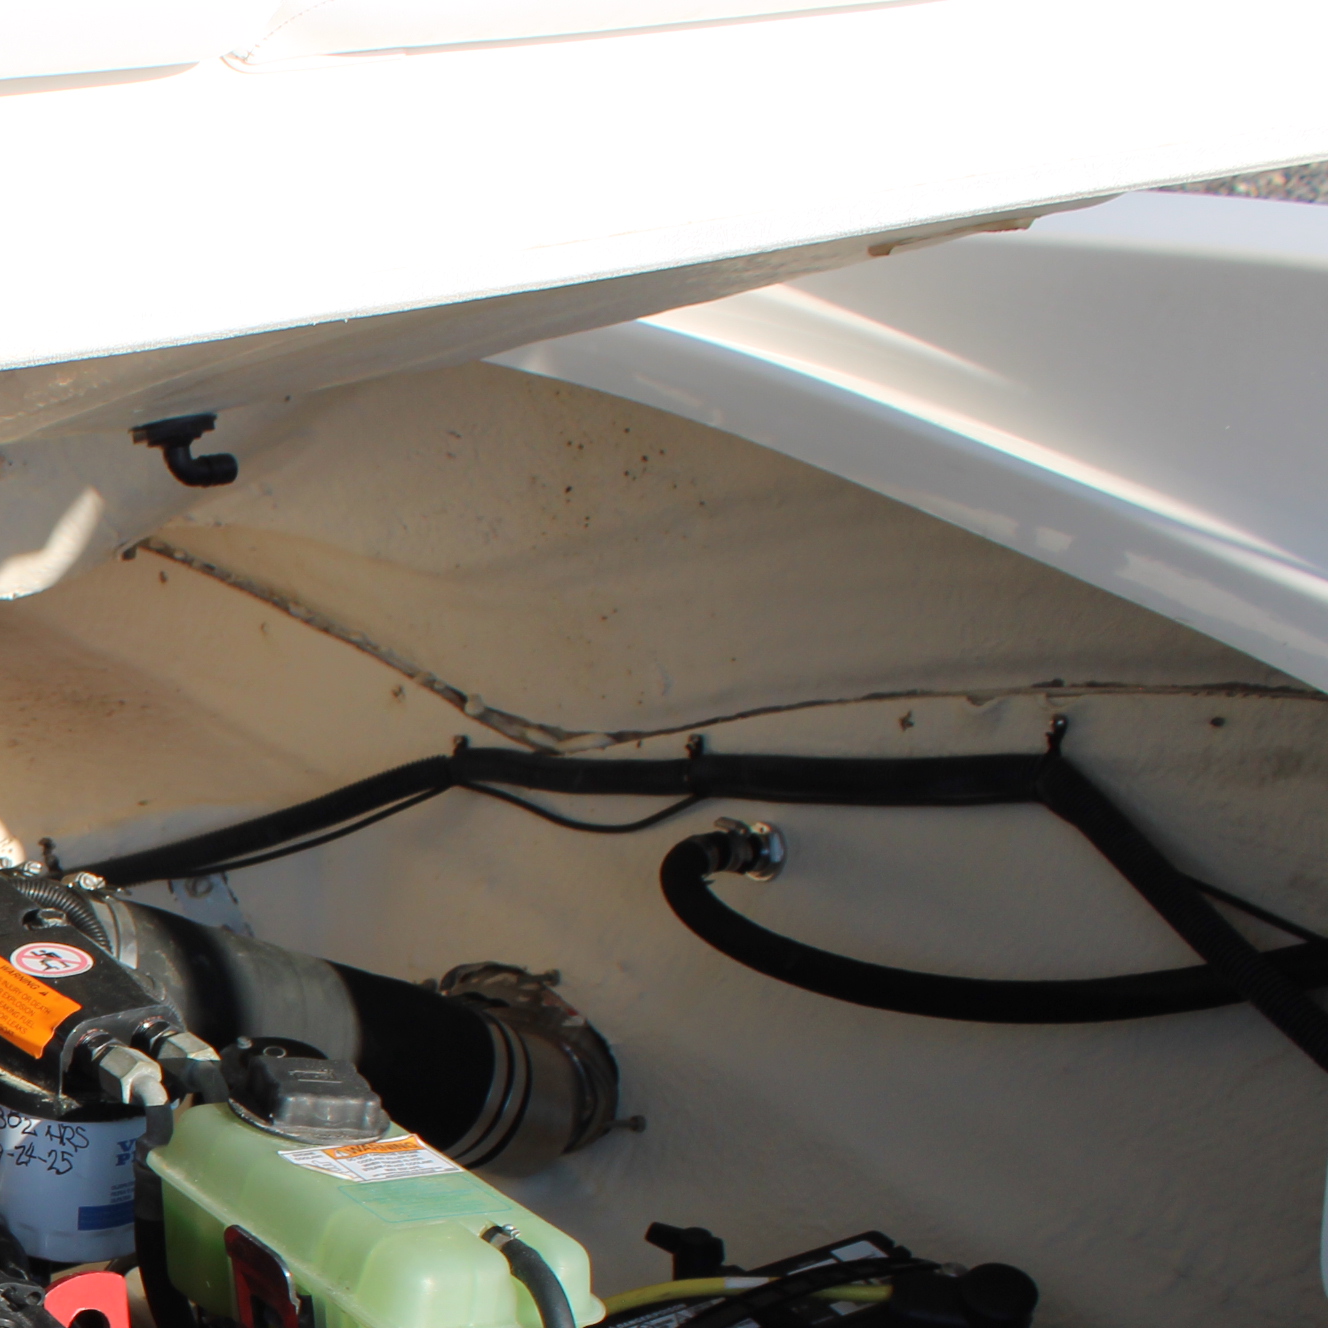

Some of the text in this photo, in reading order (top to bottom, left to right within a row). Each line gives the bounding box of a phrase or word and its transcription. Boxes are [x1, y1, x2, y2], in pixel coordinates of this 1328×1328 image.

[0, 965, 40, 990] WARNING
[2, 992, 35, 1016] EXPLOSION
[31, 1000, 51, 1014] DEATH
[45, 1123, 90, 1152] HRS
